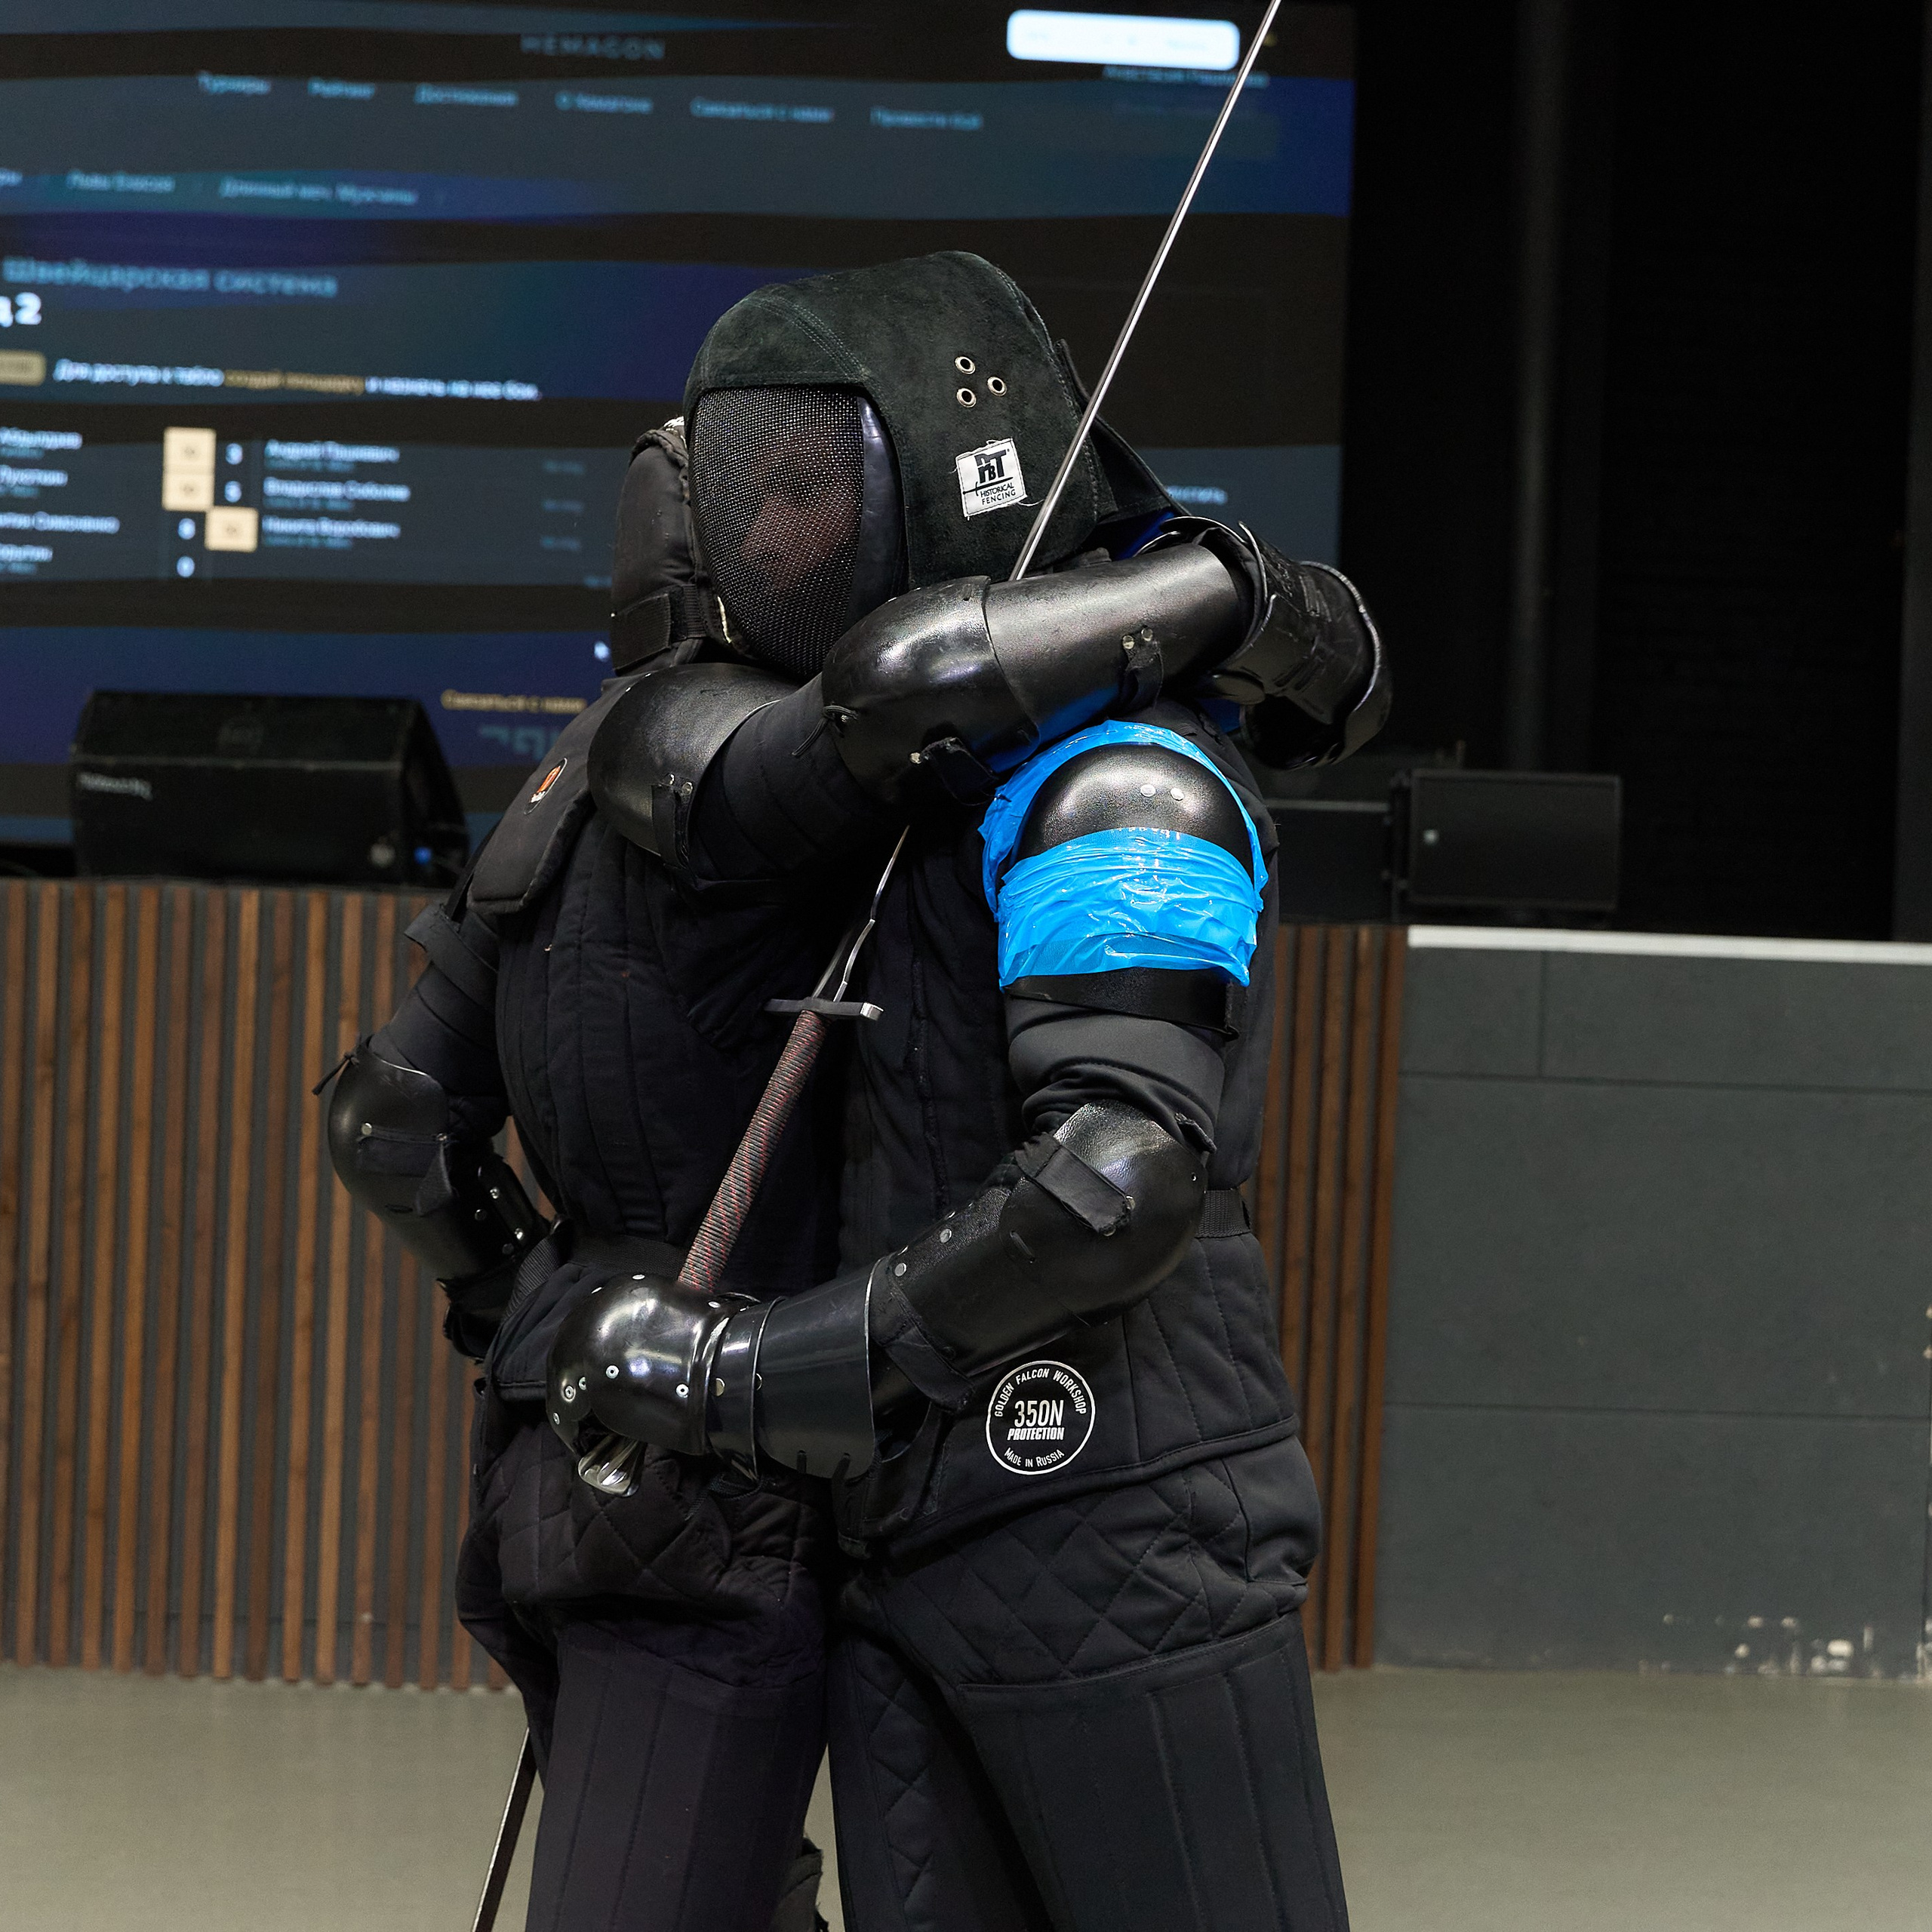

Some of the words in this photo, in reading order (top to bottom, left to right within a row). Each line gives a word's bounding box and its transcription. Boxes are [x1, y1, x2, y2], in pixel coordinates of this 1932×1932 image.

[3, 257, 209, 291] Швейцарская
[214, 269, 337, 297] система
[980, 482, 1014, 498] HISTORICAL
[982, 489, 1016, 505] FENCING
[994, 1383, 1014, 1417] GOLDEN
[1016, 1368, 1050, 1385] FALCON
[1053, 1370, 1087, 1414] WORKSHOP
[1014, 1400, 1064, 1427] 350N
[1007, 1427, 1065, 1441] PROTECTION
